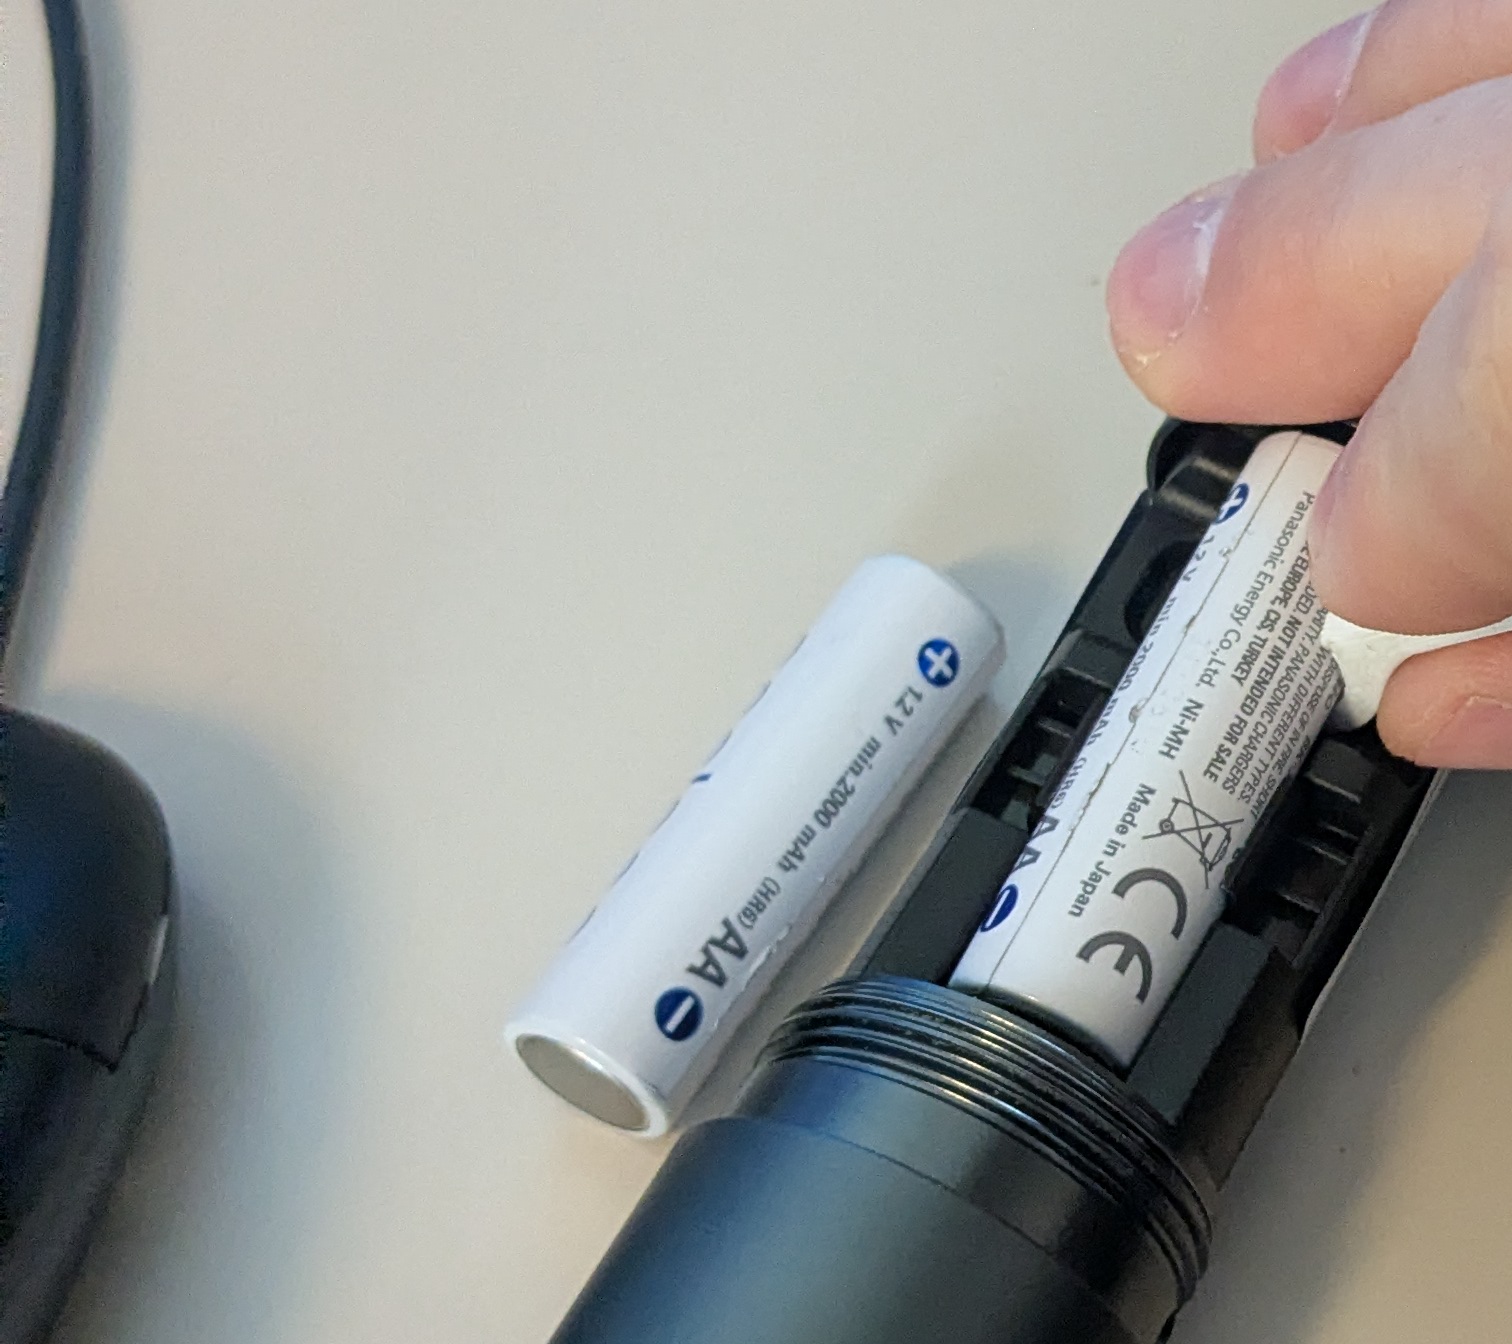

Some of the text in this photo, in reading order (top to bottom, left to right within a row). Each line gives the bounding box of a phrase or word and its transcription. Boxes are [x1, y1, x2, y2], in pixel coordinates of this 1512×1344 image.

[1263, 490, 1320, 570] Panasonic
[1229, 570, 1274, 627] Energy
[1269, 554, 1312, 609] EUROPE,
[1277, 614, 1303, 649] NOT
[1230, 634, 1268, 687] TURKEY
[1239, 644, 1287, 717] INTENDED
[1260, 642, 1311, 724] PANASONIC
[884, 715, 905, 737] V
[1158, 698, 1205, 761] Ni-MH
[1222, 714, 1249, 746] FOR
[1264, 683, 1309, 760] DIFFERENT
[1203, 743, 1233, 784] SALE
[1221, 721, 1268, 795] CHARGERS
[1236, 758, 1271, 805] TYPES.
[1114, 783, 1157, 836] Made
[777, 824, 817, 873] mAh
[1102, 839, 1126, 858] in
[1067, 860, 1112, 918] Japan
[686, 918, 750, 991] AA
